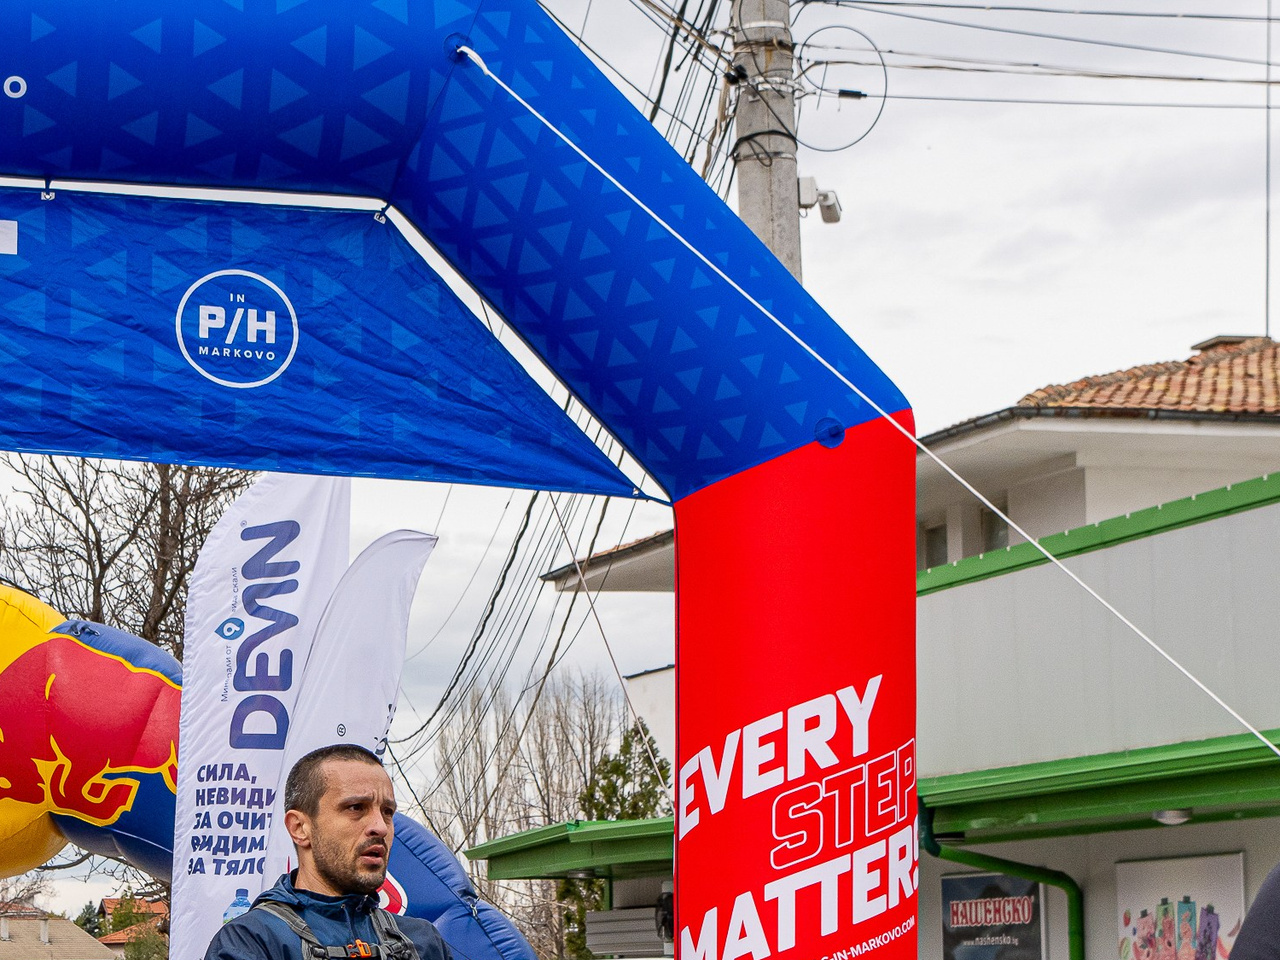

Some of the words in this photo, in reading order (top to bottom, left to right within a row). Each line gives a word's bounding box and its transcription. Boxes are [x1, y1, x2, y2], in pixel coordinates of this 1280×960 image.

[229, 293, 245, 303] IN
[198, 305, 276, 344] P/H
[199, 346, 275, 361] MARKOVO
[229, 520, 301, 750] DEVIN
[679, 674, 882, 841] EVERY
[197, 763, 257, 784] СИЛА,
[195, 787, 276, 810] НЕВИДИ
[770, 737, 916, 870] STEP
[191, 835, 267, 857] ВИДИМ
[950, 896, 1033, 928] НАШЕНСКО
